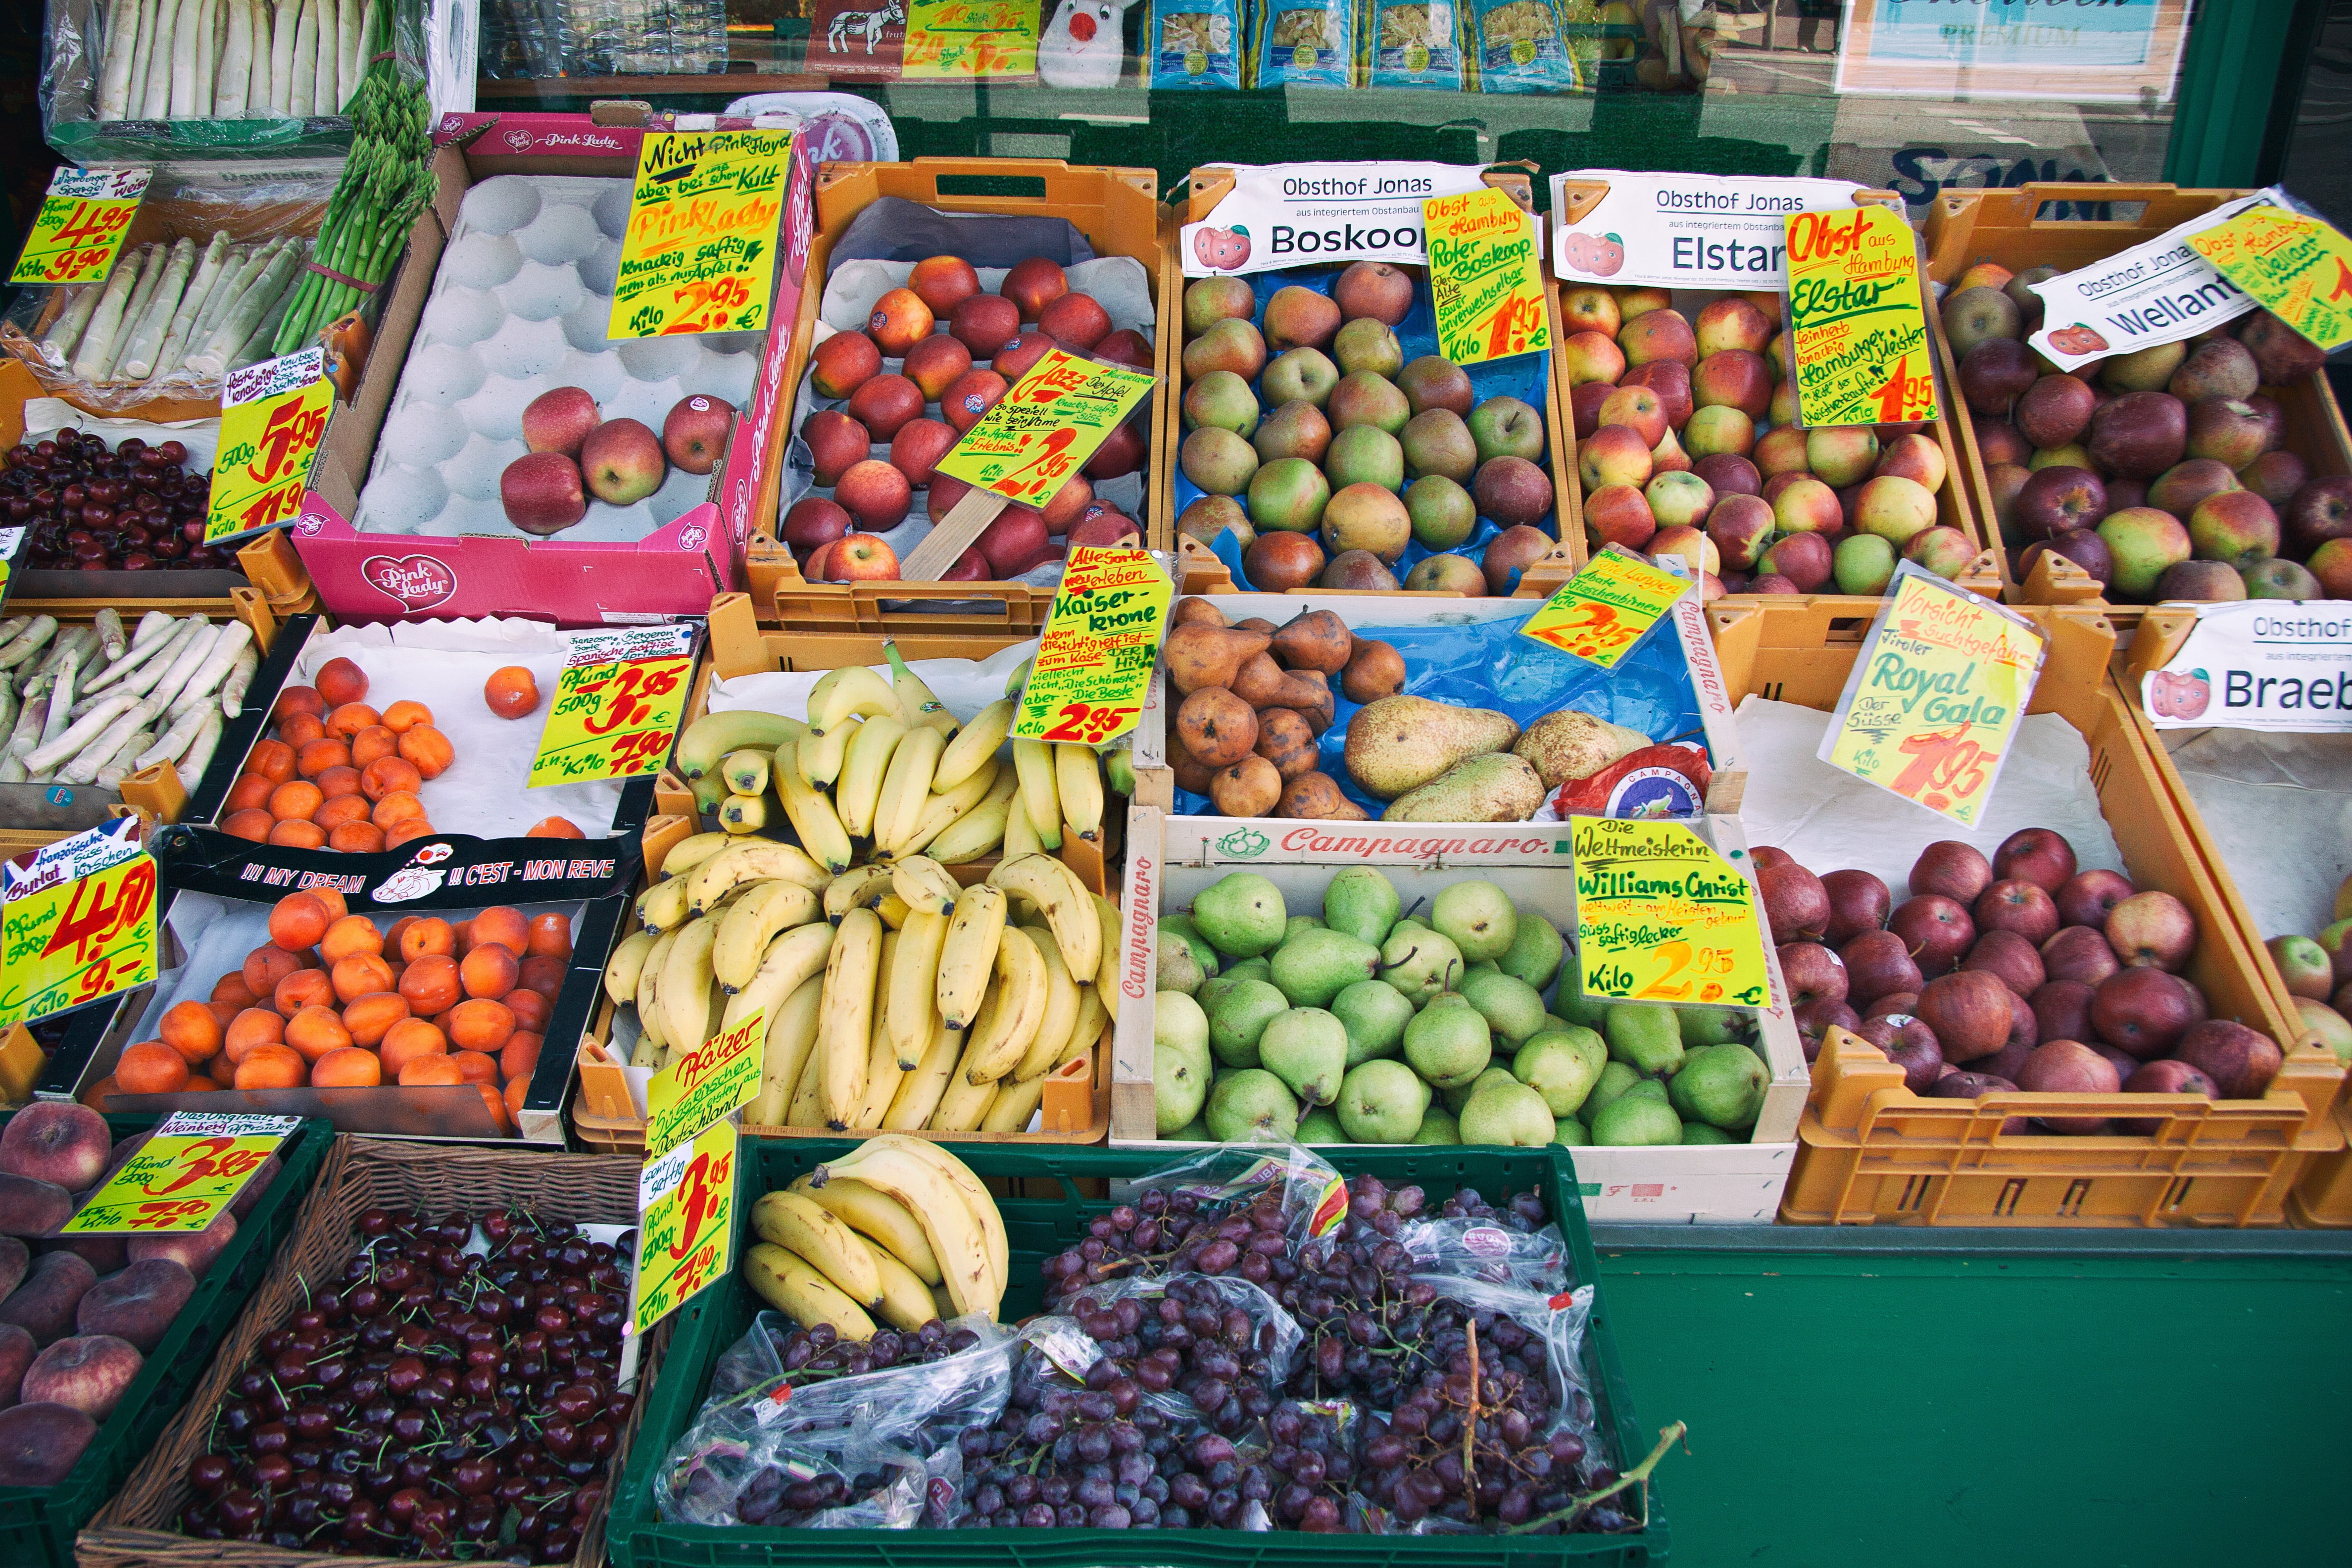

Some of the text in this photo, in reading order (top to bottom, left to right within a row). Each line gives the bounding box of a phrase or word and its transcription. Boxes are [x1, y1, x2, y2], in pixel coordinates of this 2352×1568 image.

[904, 30, 945, 65] 20
[1940, 24, 2081, 46] PREMIUM
[535, 134, 623, 149] Pink Lady
[645, 135, 705, 173] Nicht
[59, 182, 105, 196] Spargel
[636, 180, 672, 200] aber
[678, 174, 703, 194] bei
[736, 165, 780, 190] Kult
[1283, 178, 1432, 196] Obsthof Jonas
[1313, 208, 1369, 218] integriertem
[1372, 206, 1419, 215] Obstanbau
[1426, 195, 1497, 221] Obst aus
[1657, 190, 1804, 210] Obsthof Jonas
[1449, 209, 1522, 237] Hamburg
[1686, 221, 1741, 231] integriertem
[1743, 222, 1784, 232] Obstanba
[1787, 209, 1895, 262] Obst aus
[1430, 238, 1480, 269] Roter
[2194, 229, 2237, 256] Obst
[13, 259, 45, 277] Kilo
[1843, 250, 1914, 276] Hamburg
[647, 272, 666, 290] als
[2078, 261, 2146, 296] Obsthof
[1439, 267, 1523, 335] unverwechselbar
[1439, 294, 1466, 321] sauer
[2105, 273, 2243, 335] Wellant
[629, 305, 663, 331] Kilo
[1797, 321, 1850, 349] feinherb
[1450, 334, 1480, 362] Kilo
[1797, 341, 1844, 367] knackig
[1800, 330, 1884, 387] Hamburger
[227, 361, 320, 397] feste aus
[984, 413, 1001, 422] wie
[1006, 416, 1028, 428] sein
[1007, 405, 1047, 415] speziell
[1844, 406, 1873, 423] Kilo
[970, 427, 990, 437] Ein
[980, 464, 1003, 477] Kilo
[211, 520, 235, 538] Kilo
[376, 562, 432, 588] Pink
[1090, 567, 1149, 586] erleben
[1598, 561, 1681, 594] Die Langen
[396, 578, 451, 598] Lady
[1568, 580, 1663, 614] Flaschenbirnen
[1551, 595, 1576, 608] Kilo
[1899, 583, 1983, 630] Vorsicht
[1044, 629, 1075, 640] wenn
[2253, 617, 2351, 637] Obsthof
[567, 640, 675, 665] Spanische saftige
[618, 647, 682, 661] Aprikosen
[1040, 640, 1058, 652] die
[1882, 629, 1932, 656] Tiroler
[1037, 656, 1065, 667] zum
[1677, 600, 1725, 714] Campagnaro
[561, 663, 619, 692] Pfund
[1029, 681, 1058, 690] nicht
[1033, 668, 1085, 681] vielleicht
[1872, 652, 1975, 713] Royal
[1024, 693, 1059, 705] aber
[1858, 697, 1889, 711] Der
[1924, 696, 2006, 725] Gala
[1017, 722, 1045, 734] Kilo
[1847, 712, 1902, 727] Süsse
[563, 753, 605, 776] Kilo
[1853, 748, 1880, 769] Kilo
[1598, 820, 1634, 834] Die
[1575, 827, 1710, 858] Weltmeisterin
[263, 867, 299, 885] MY
[466, 860, 615, 885] C'EST MON REVE
[1578, 871, 1748, 897] Williams Christ
[1579, 899, 1632, 914] weltweit
[5, 902, 57, 941] Pfund
[1122, 856, 1152, 999] Campagnaro
[1588, 964, 1633, 991] Kilo
[28, 990, 69, 1018] Kilo
[675, 1016, 762, 1087] Pfälzer
[743, 1070, 761, 1083] aus
[161, 1121, 227, 1133] Weinberg
[654, 1083, 742, 1158] Deutschland
[124, 1156, 176, 1173] Pfund
[81, 1213, 122, 1227] Kilo
[640, 1291, 668, 1327] Kilo
